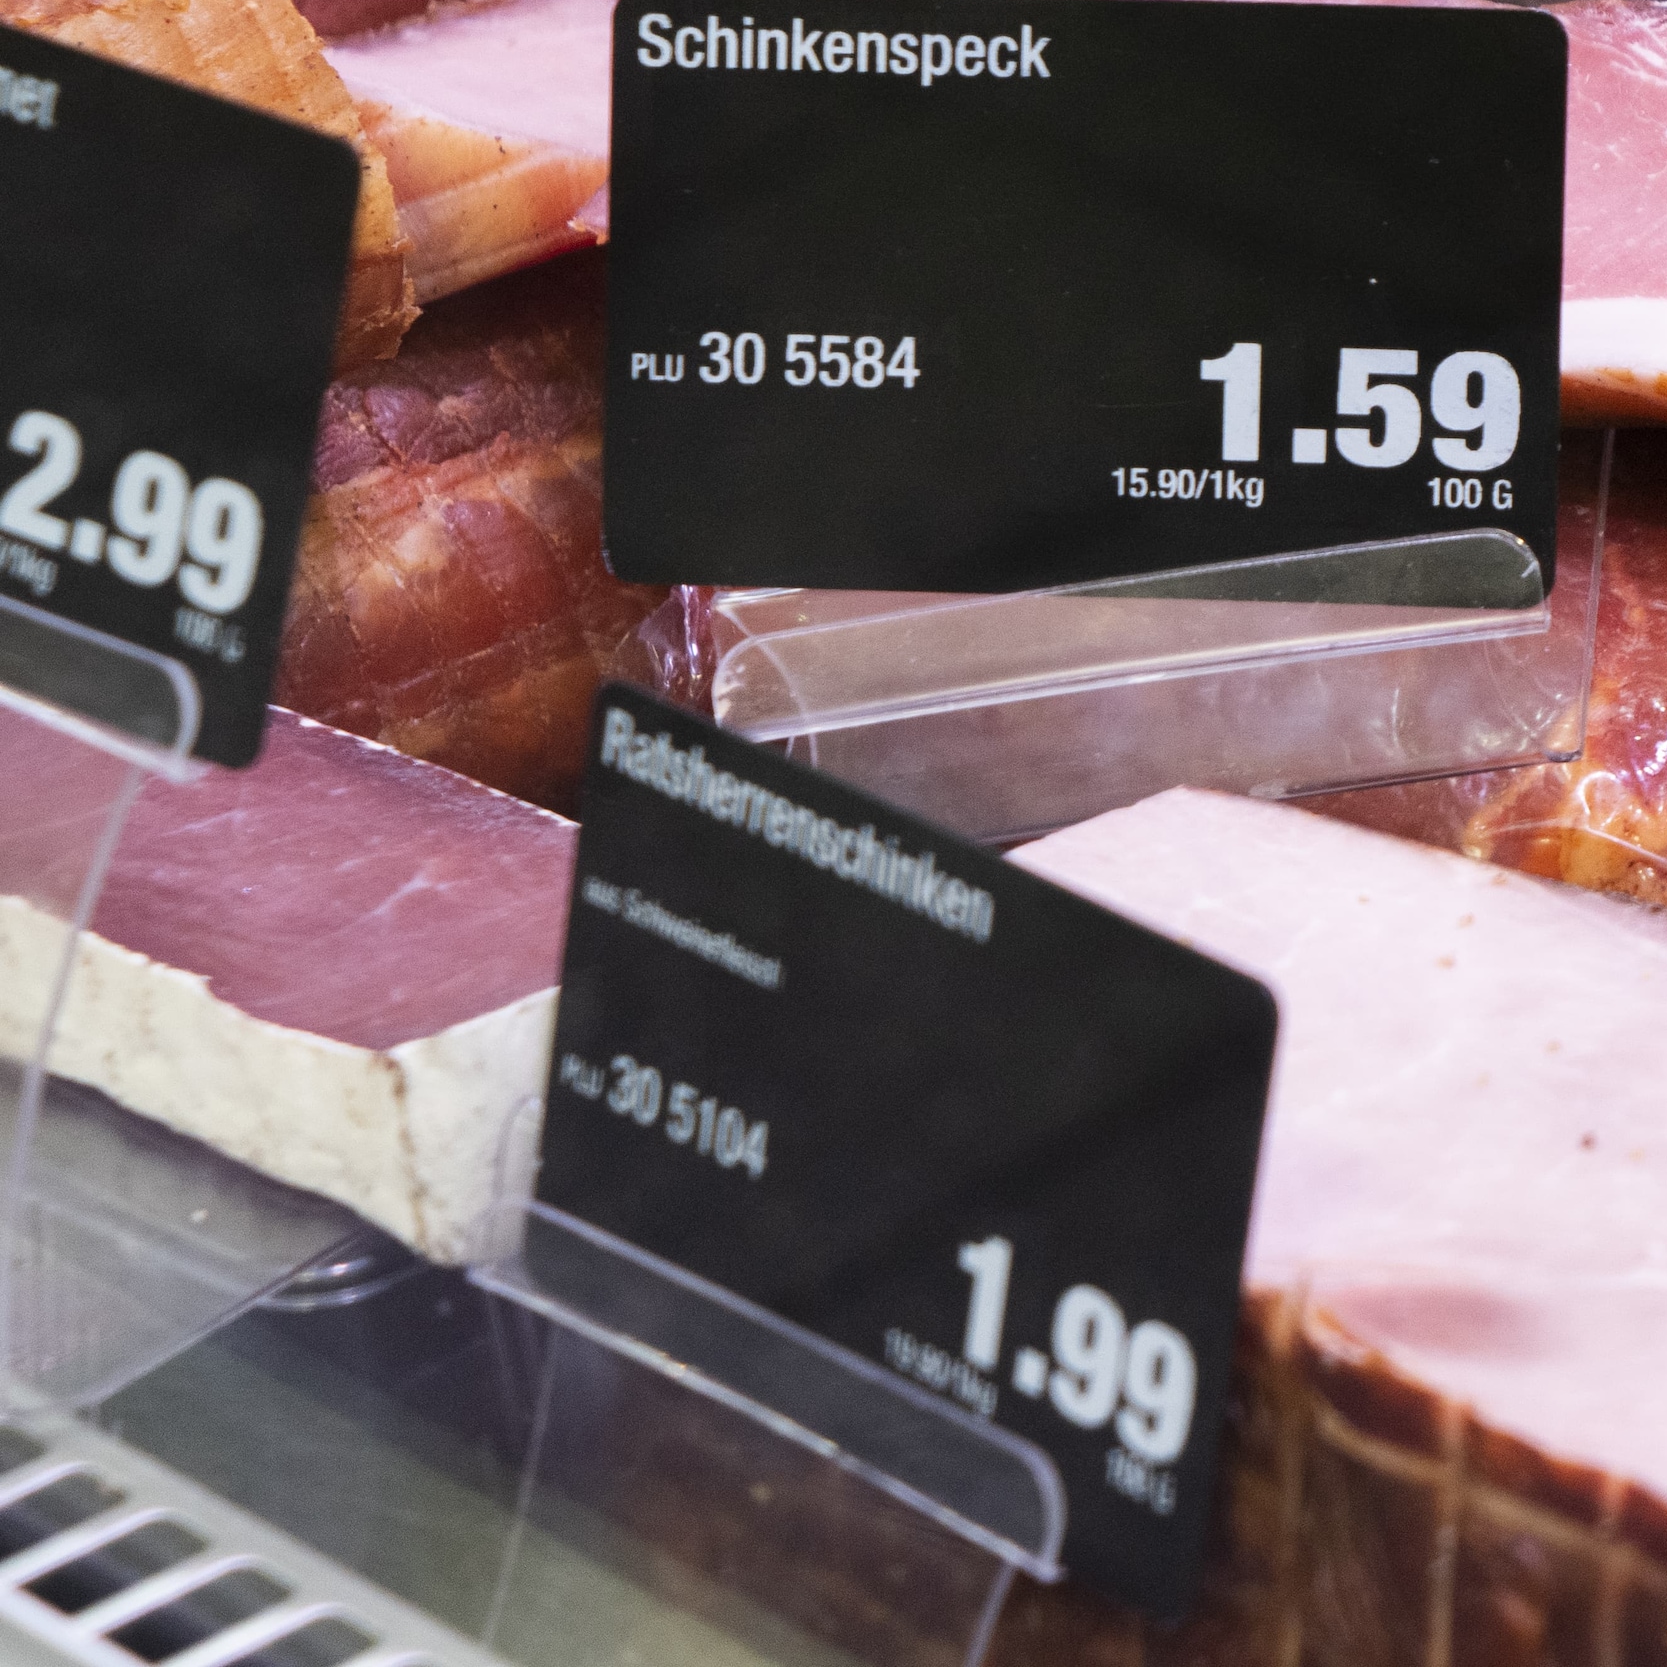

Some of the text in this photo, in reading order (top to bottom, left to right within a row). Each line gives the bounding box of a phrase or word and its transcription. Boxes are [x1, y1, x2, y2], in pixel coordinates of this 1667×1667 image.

[637, 11, 1052, 87] Schinkenspeck
[631, 330, 921, 390] PLU 30 5584
[1201, 342, 1522, 473] 1.59
[0, 409, 263, 615] 2.99
[1111, 467, 1267, 509] 15.90/1kg
[1427, 476, 1514, 511] 100 G
[600, 706, 996, 942] Ratsherrenschinken
[559, 1051, 769, 1180] PLU 30 5104
[957, 1234, 1197, 1463] 1.99
